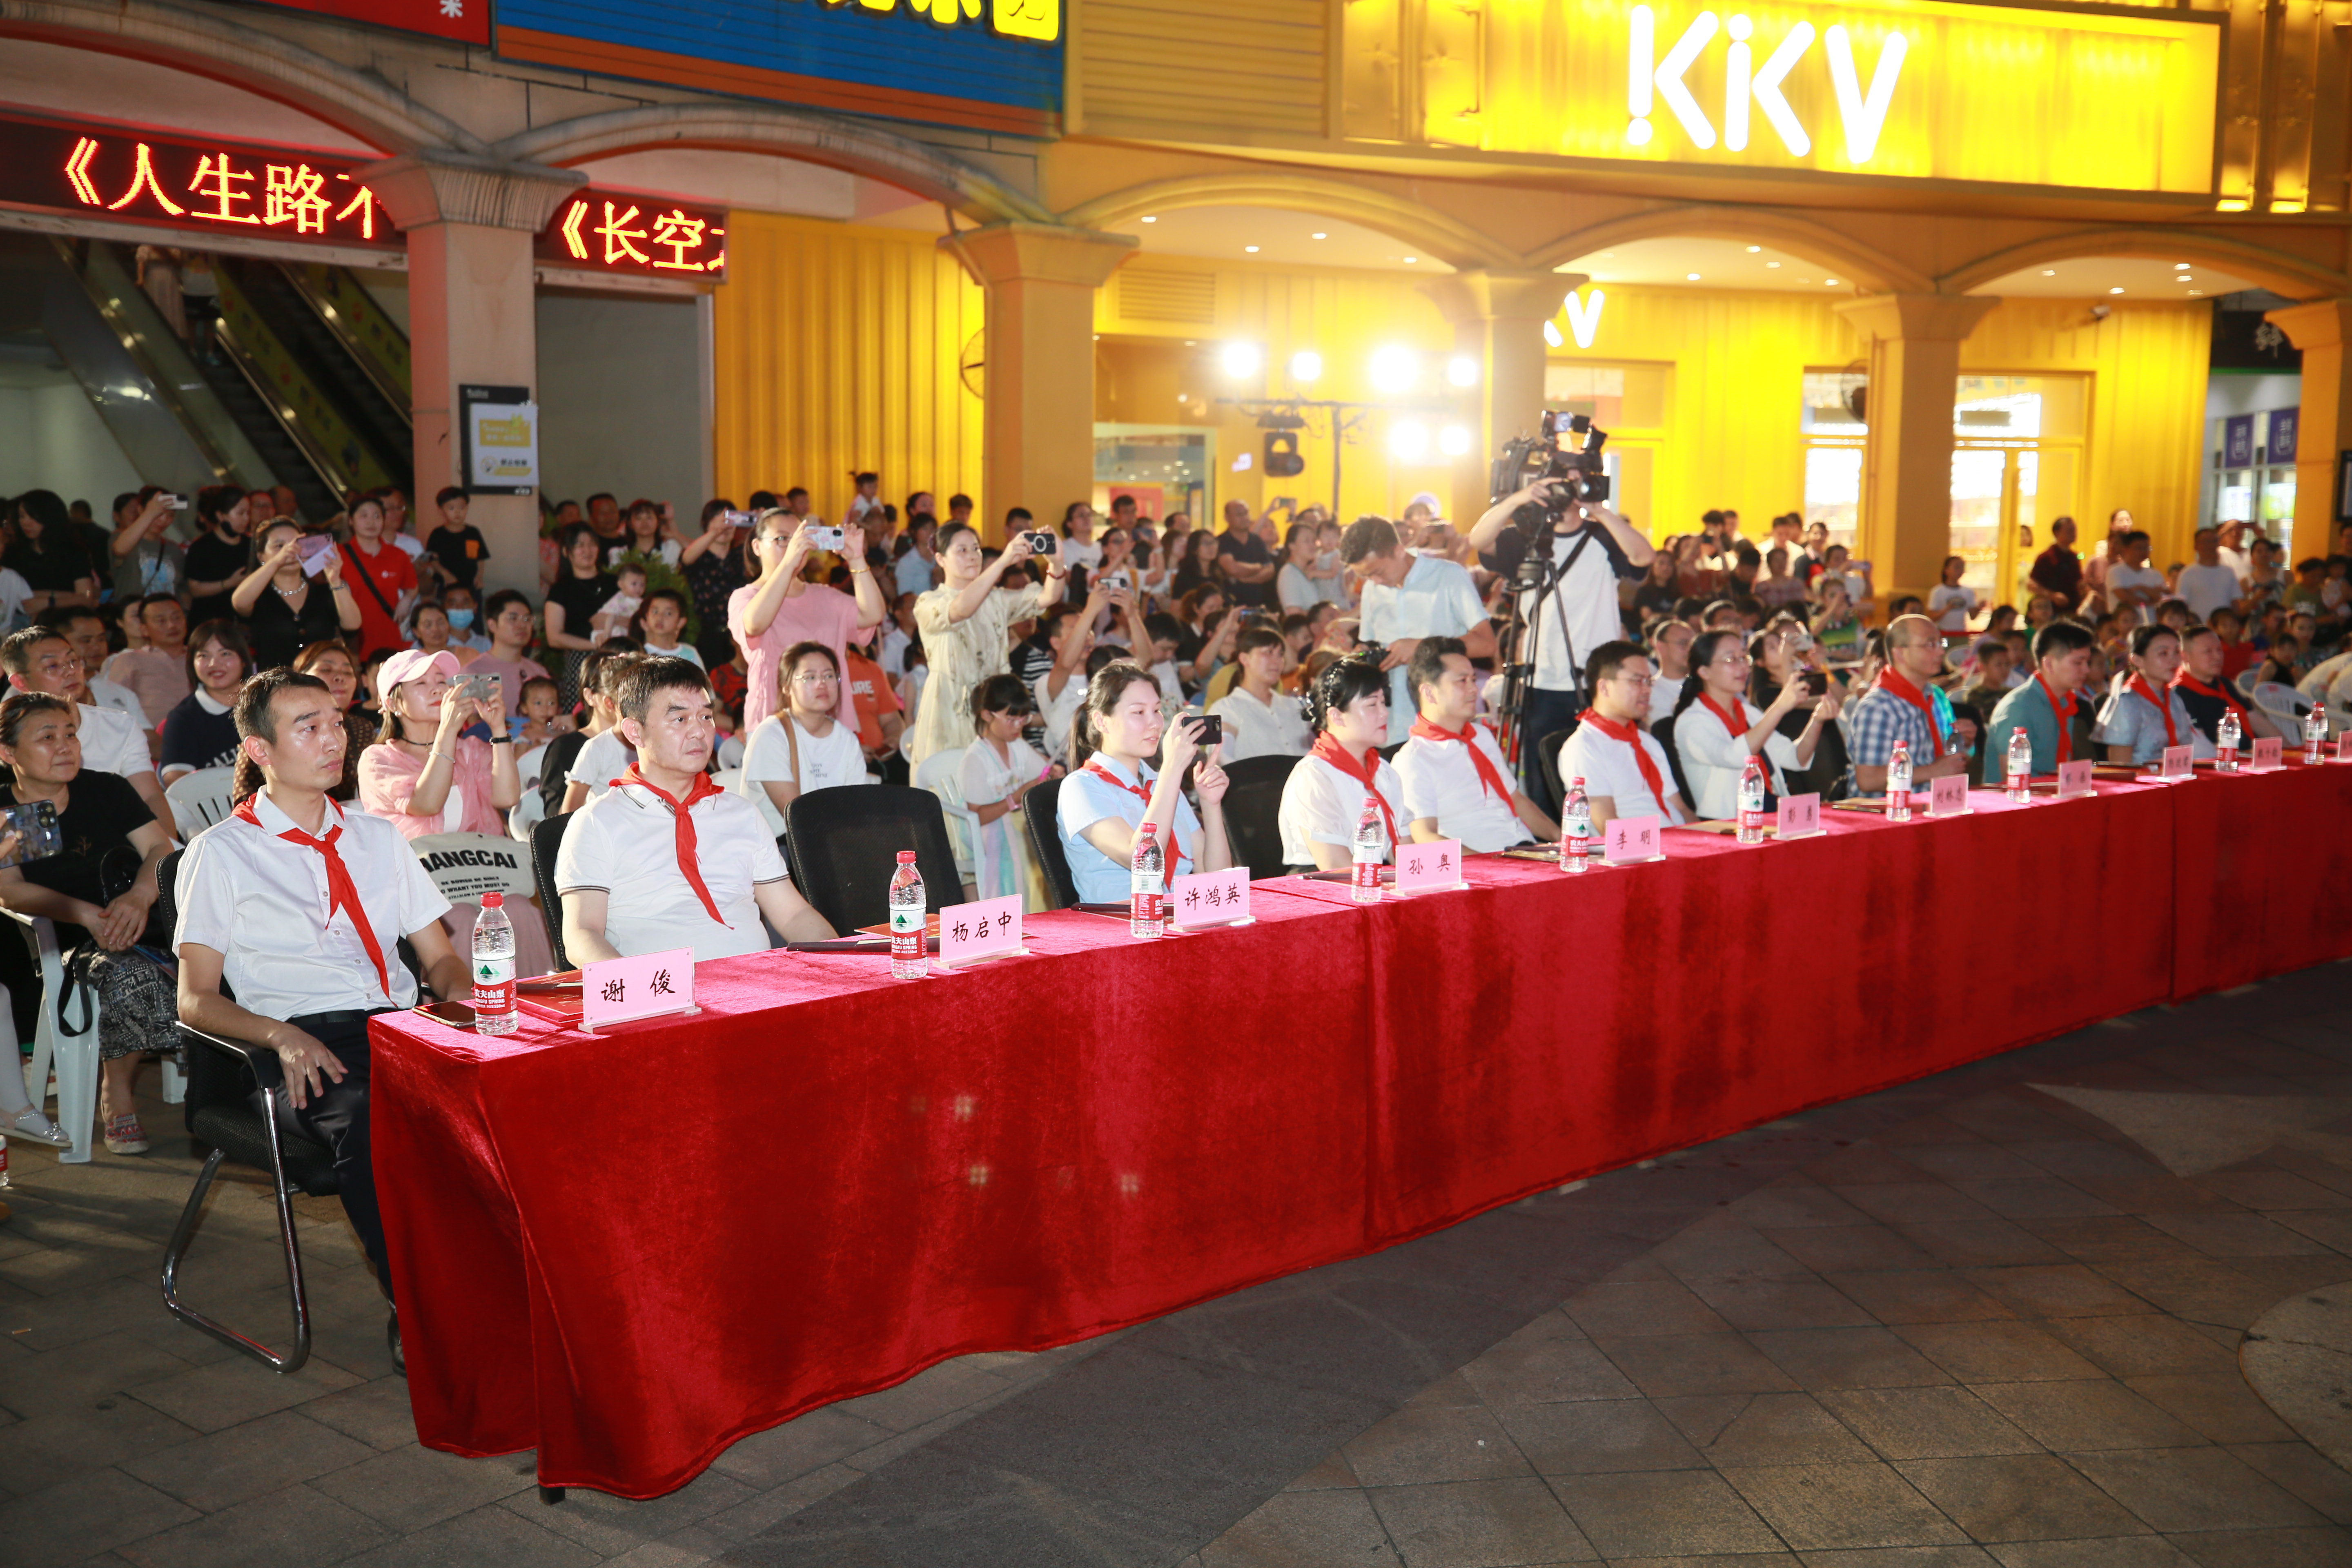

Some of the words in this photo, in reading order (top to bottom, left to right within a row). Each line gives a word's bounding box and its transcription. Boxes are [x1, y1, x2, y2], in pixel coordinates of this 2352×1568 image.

[1617, 829, 1650, 849] 李明
[1185, 883, 1240, 911] 许鸿英
[952, 911, 1012, 942] 杨启中
[891, 935, 917, 945] 农夫山泉
[474, 989, 505, 999] 农夫山泉
[601, 969, 676, 1002] 谢俊
